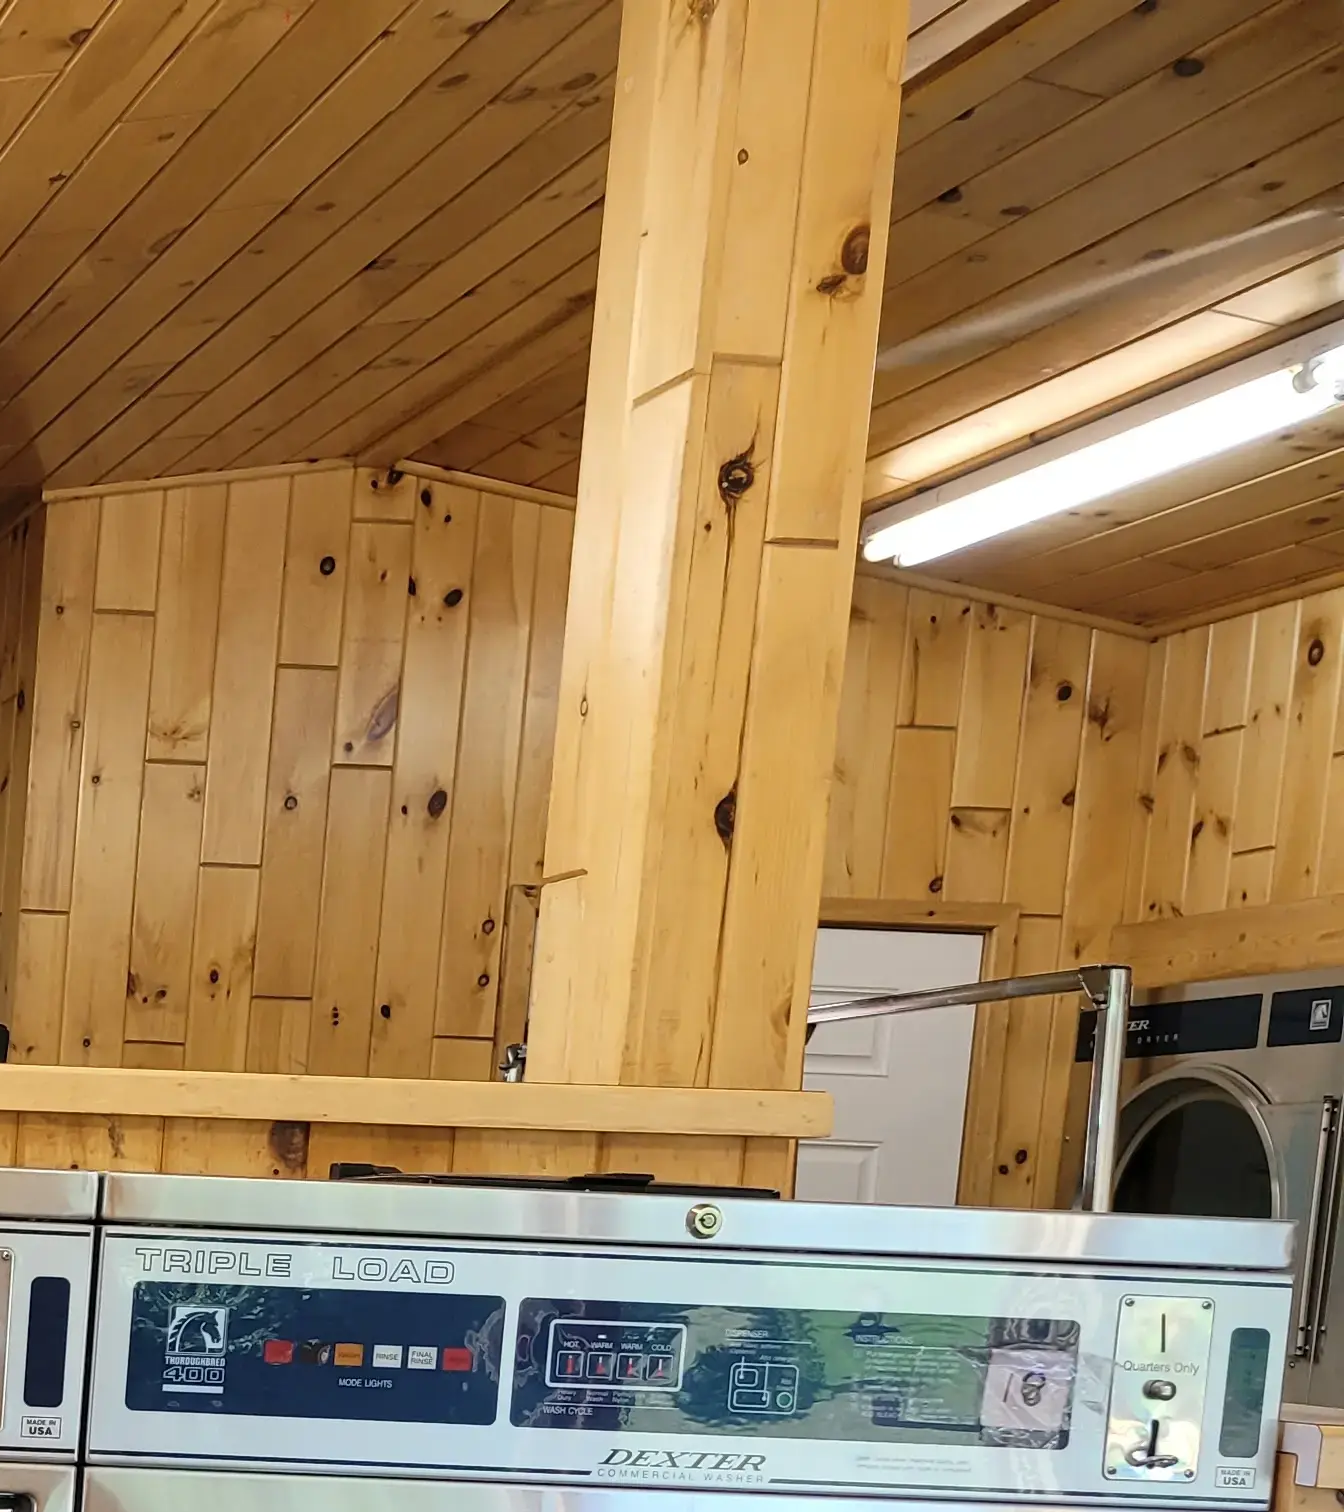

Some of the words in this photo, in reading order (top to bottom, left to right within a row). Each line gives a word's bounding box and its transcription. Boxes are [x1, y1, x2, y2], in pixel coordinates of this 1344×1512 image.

[135, 1248, 292, 1277] TRIPLE
[332, 1256, 455, 1284] LOAD
[375, 1353, 399, 1361] RINSE
[411, 1351, 433, 1359] FINAL
[165, 1356, 225, 1367] THOROUGHBRED
[411, 1358, 433, 1366] RINSE
[1123, 1360, 1171, 1373] Quarters
[1174, 1362, 1200, 1376] Only
[163, 1366, 225, 1383] 400
[338, 1378, 362, 1387] MODE
[365, 1379, 393, 1389] LIGHTS
[543, 1406, 566, 1414] WASH
[568, 1407, 593, 1415] CYCLE
[29, 1426, 52, 1435] USA
[598, 1449, 767, 1471] DEXTER
[597, 1468, 694, 1481] COMMERCIAL
[704, 1471, 764, 1483] WASHER
[1223, 1477, 1246, 1486] USA
